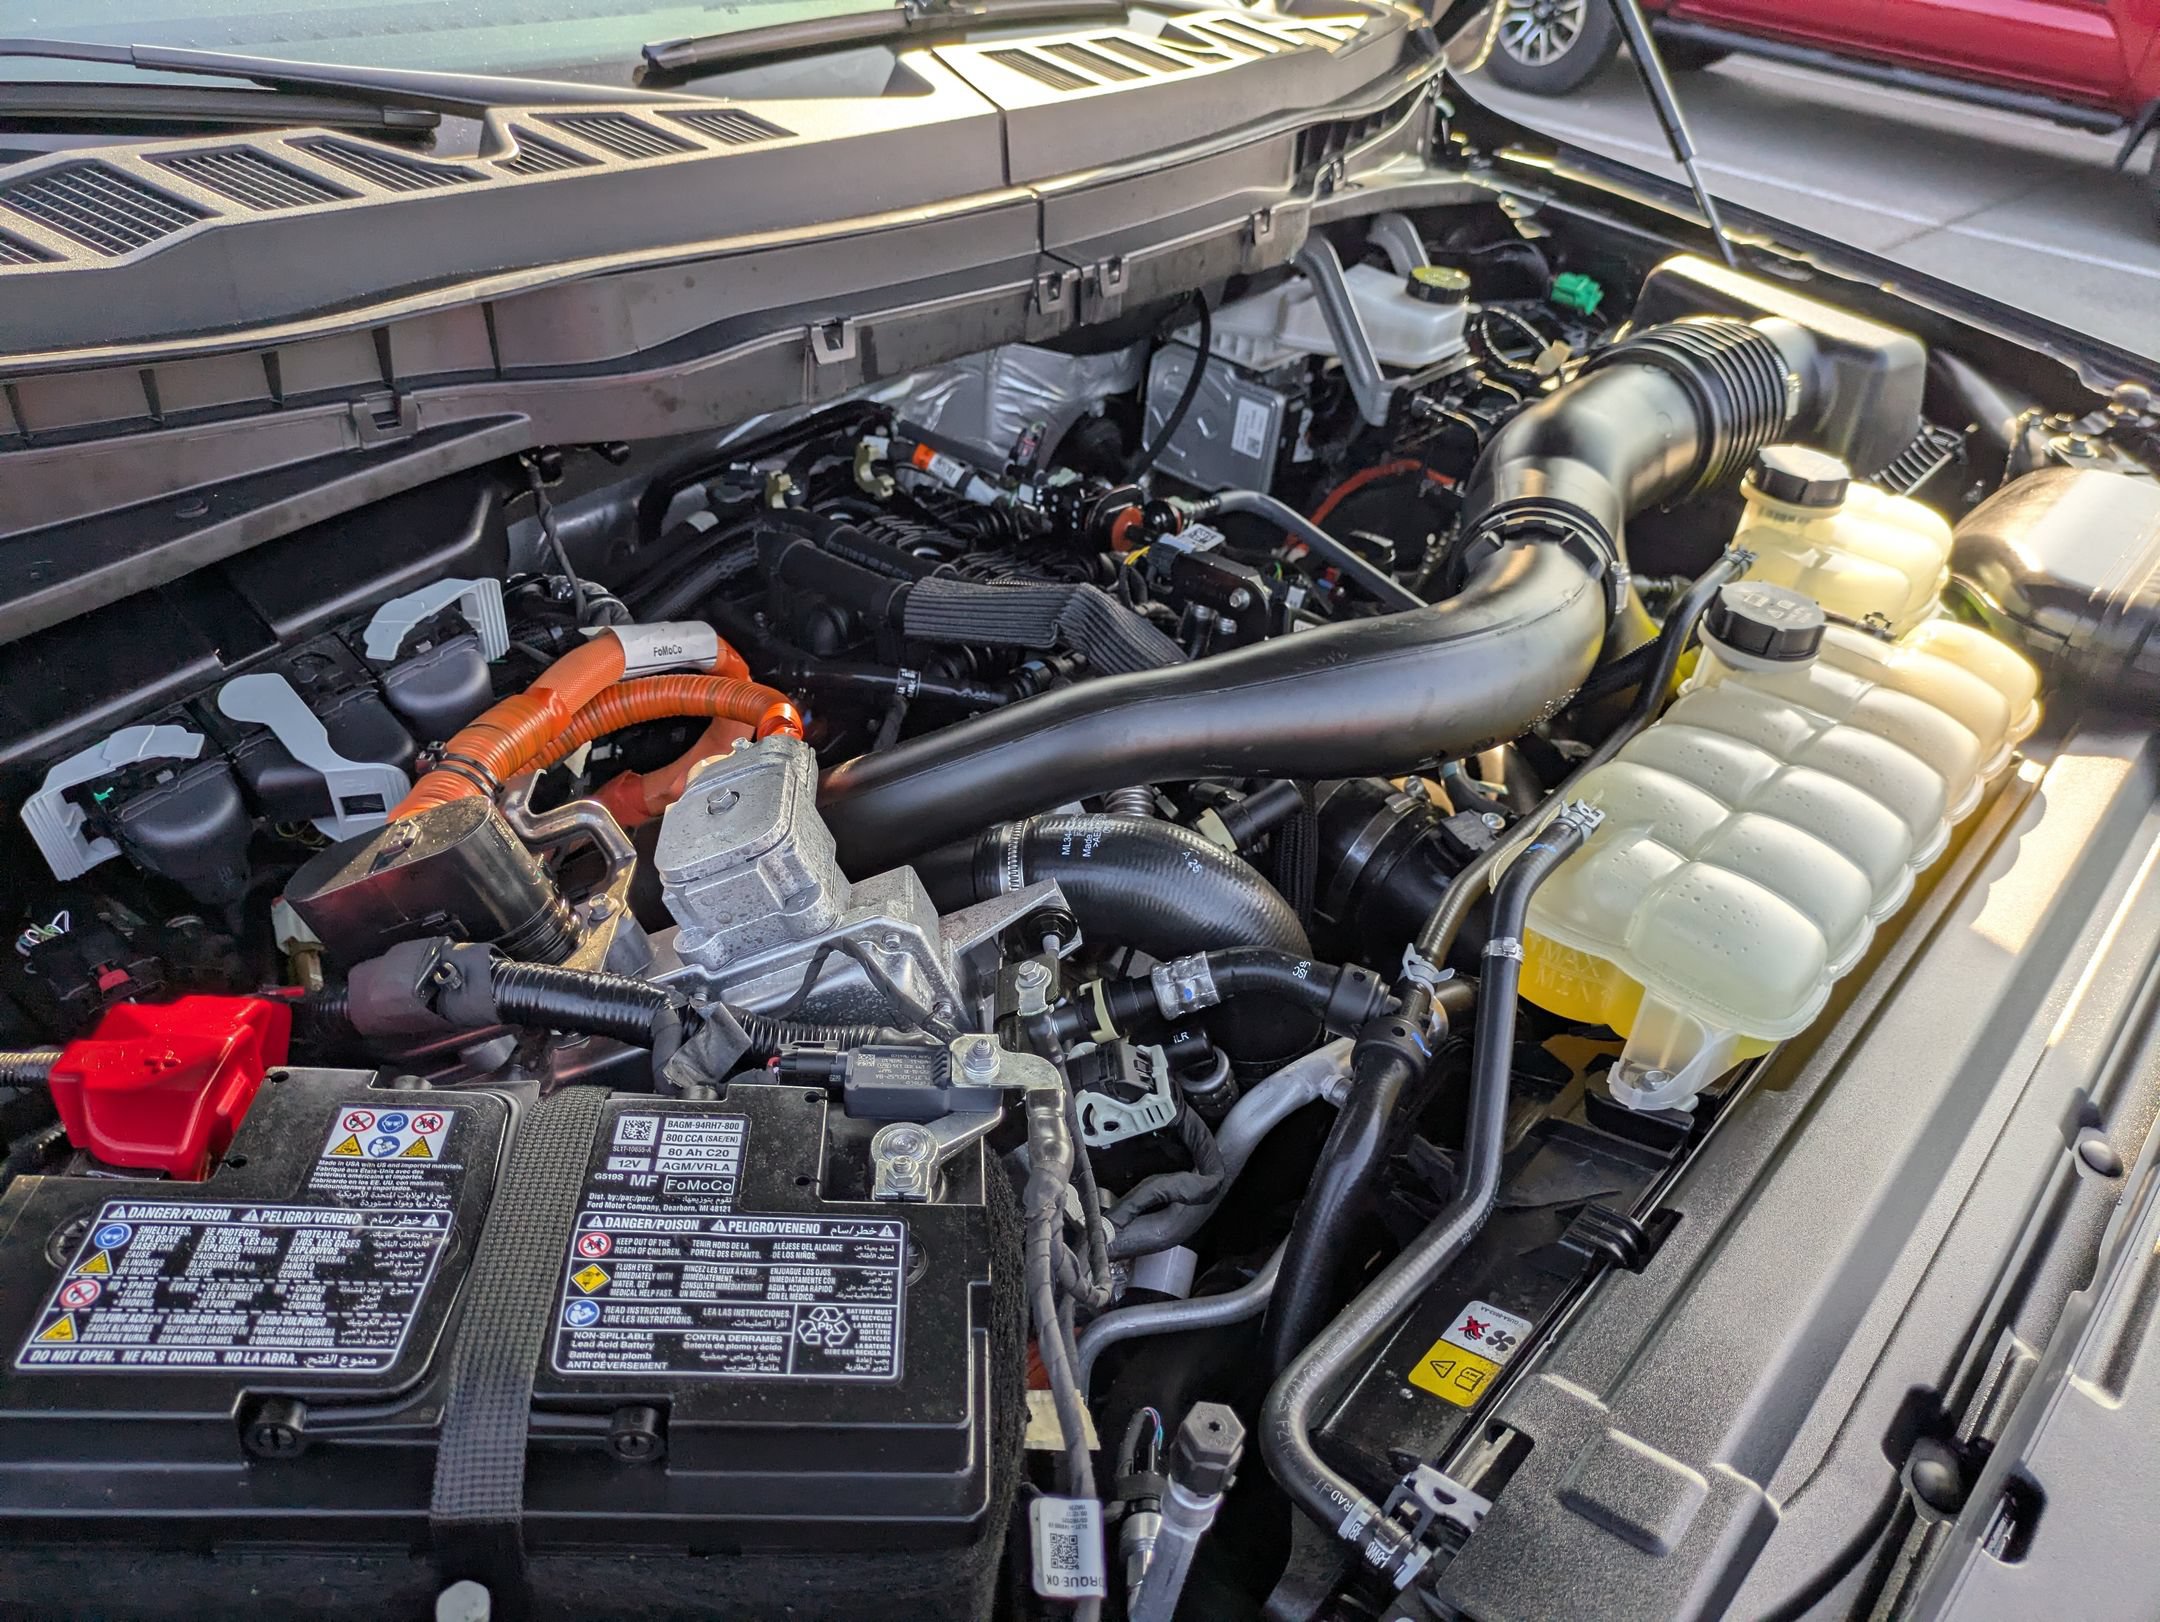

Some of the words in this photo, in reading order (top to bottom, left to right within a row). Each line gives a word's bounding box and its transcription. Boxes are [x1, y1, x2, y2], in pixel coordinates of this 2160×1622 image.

[653, 644, 682, 657] FoMoCo
[1082, 834, 1093, 857] Made
[1292, 966, 1308, 980] ISC
[668, 1120, 740, 1130] BAGM-94RH7-800
[666, 1133, 682, 1142] 800
[685, 1134, 703, 1142] CCA
[686, 1148, 702, 1156] Ah
[706, 1149, 730, 1157] C20
[618, 1159, 641, 1168] 12V
[662, 1162, 730, 1171] AGM/VRLA
[630, 1174, 659, 1186] MF
[666, 1179, 732, 1191] FoMoCo
[627, 1203, 661, 1213] Company,
[128, 1207, 231, 1221] DANGER/POISON
[261, 1211, 361, 1225] PELIGRO/VENENO
[605, 1218, 699, 1230] DANGER/POISON
[729, 1222, 820, 1234] PELIGRO/VENENO
[138, 1227, 168, 1235] SHIELD
[169, 1227, 192, 1235] EYES.
[204, 1228, 216, 1236] SE
[217, 1227, 260, 1237] PROTÉGER
[296, 1230, 332, 1238] PROTEJA
[773, 1242, 800, 1251] ALÉJESE
[647, 1248, 681, 1256] CHILDREN.
[690, 1248, 715, 1257] PORTÉE
[796, 1251, 817, 1259] NIÑOS.
[30, 1350, 50, 1362] DO
[52, 1350, 77, 1362] NOT
[80, 1351, 115, 1362] OPEN.
[122, 1351, 139, 1362] NE
[141, 1351, 166, 1362] PAS
[170, 1351, 217, 1362] OUVRIR.
[224, 1353, 244, 1363] NO
[247, 1353, 263, 1364] LA
[265, 1353, 297, 1364] ABRA.
[593, 1360, 667, 1369] DÉVERSEMENT
[1046, 1574, 1060, 1586] OK
